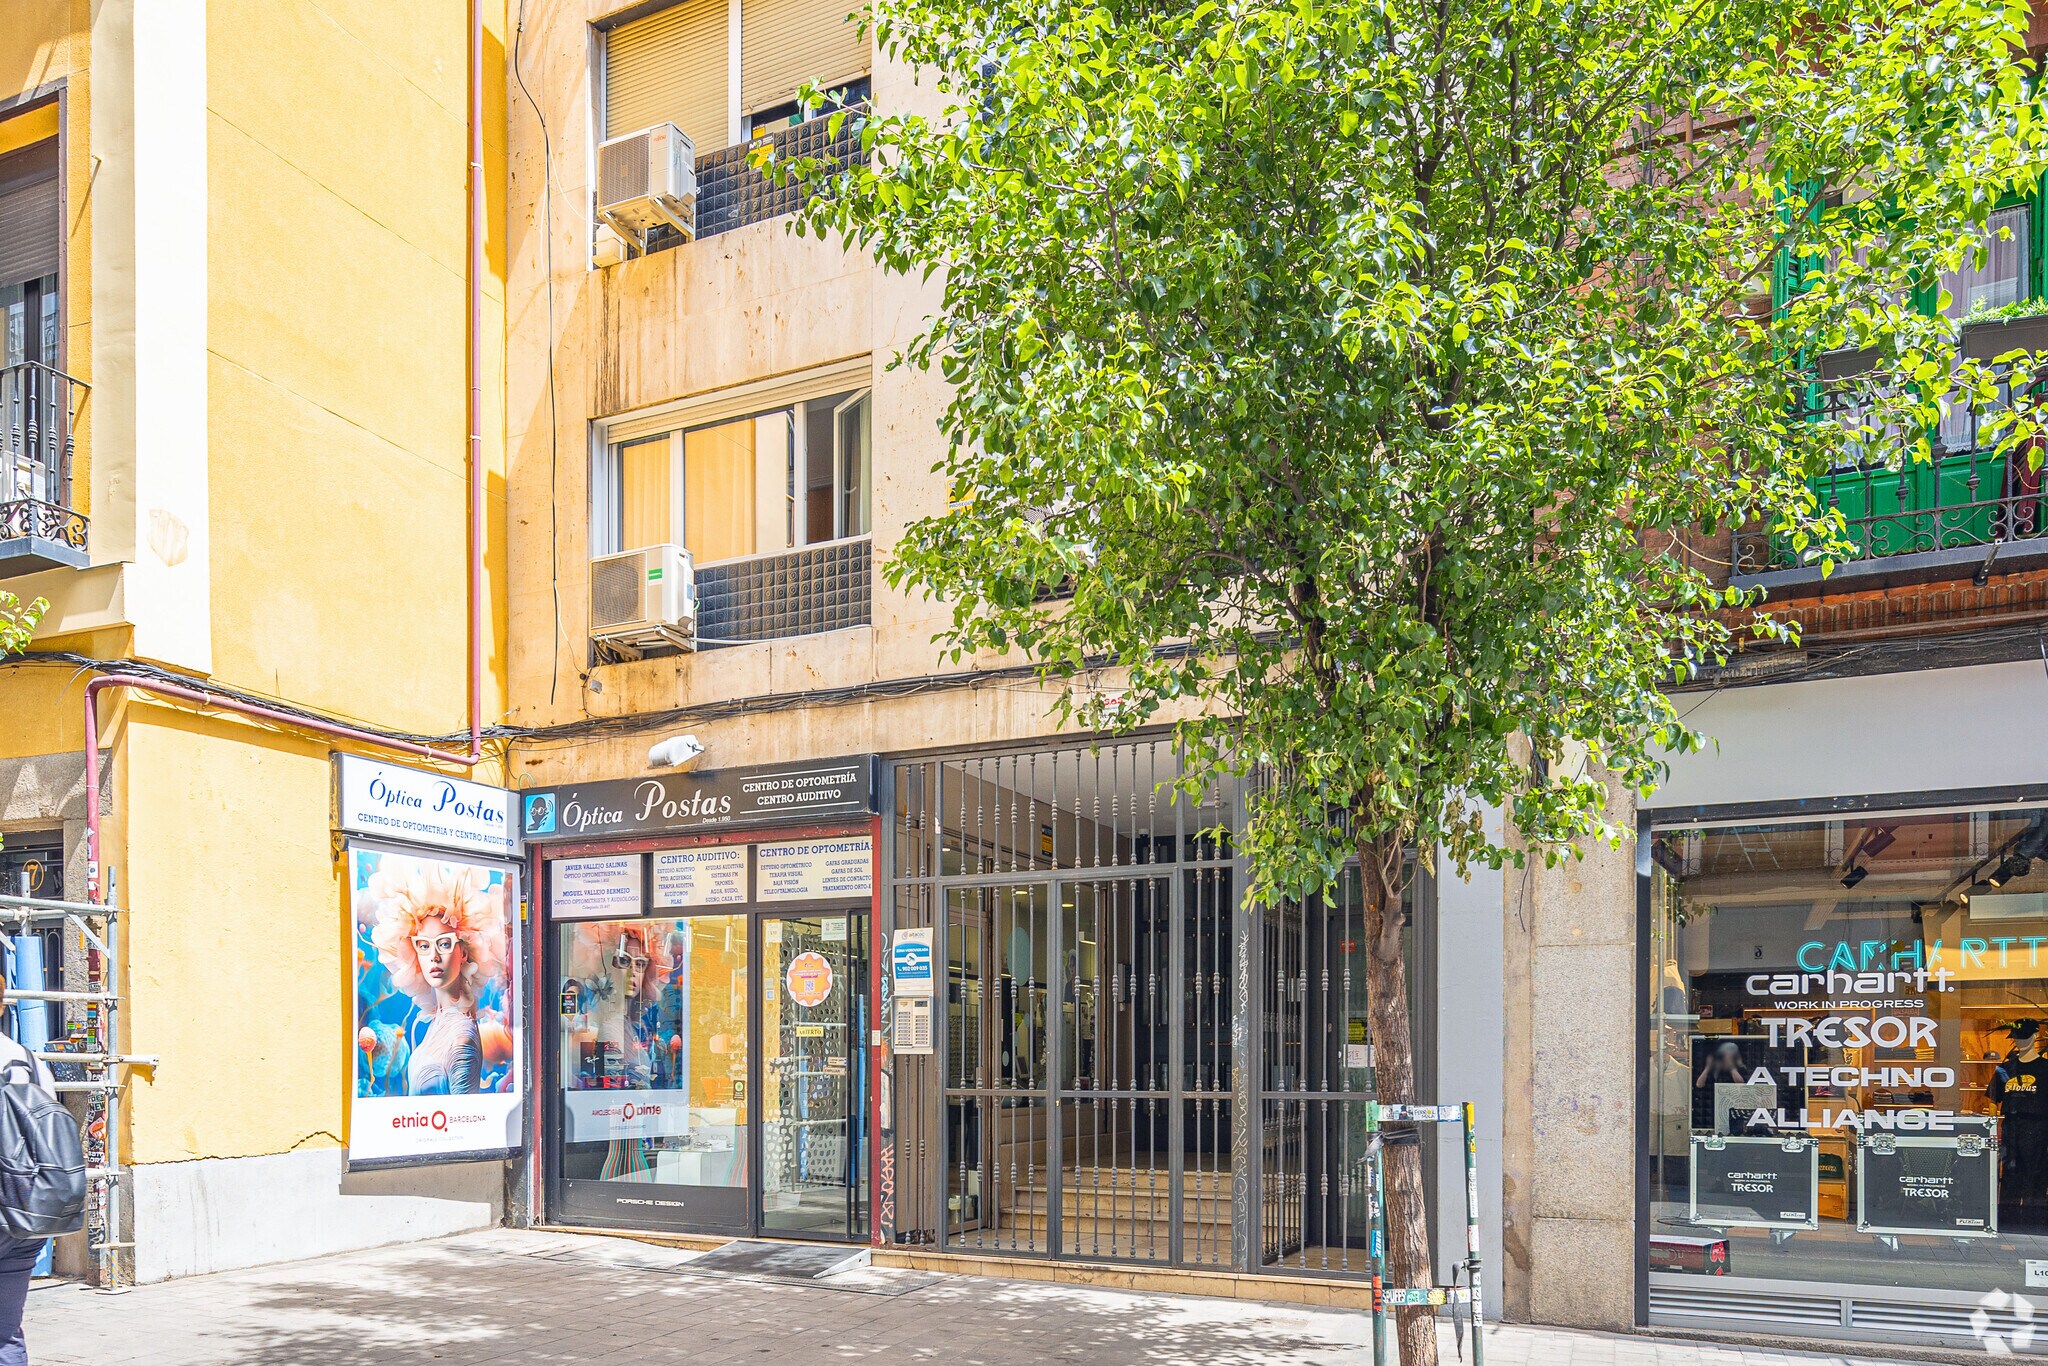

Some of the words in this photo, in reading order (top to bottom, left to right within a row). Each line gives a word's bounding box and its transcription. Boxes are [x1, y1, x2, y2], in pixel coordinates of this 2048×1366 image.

[742, 780, 780, 793] CENTRO
[782, 778, 794, 789] DE
[796, 771, 857, 787] OPTOMETRÍA
[369, 771, 422, 807] Óptica
[433, 780, 505, 823] Postas
[757, 793, 795, 806] CENTRO
[796, 789, 841, 802] AUDITIVO
[562, 792, 624, 832] Óptica
[634, 780, 732, 822] Postas
[702, 816, 717, 824] Desde
[358, 813, 389, 826] CENTRO
[391, 818, 401, 828] DE
[448, 828, 454, 837] Y
[456, 830, 482, 842] CENTRO
[483, 832, 514, 847] AUDITIVO
[660, 854, 694, 864] CENTRO
[696, 851, 740, 862] AUDITIVO:
[760, 847, 796, 858] CENTRO
[797, 846, 809, 855] DE
[565, 864, 582, 872] JAVIER
[841, 858, 869, 866] GRADUADAS
[27, 864, 39, 886] 7
[1774, 1000, 1818, 1010] WORK
[1822, 1000, 1836, 1008] IN
[1840, 1000, 1924, 1009] PROGRESS
[1760, 1016, 1939, 1048] TRESOR
[1746, 1066, 1777, 1086] A
[1780, 1067, 1955, 1088] TECHNO
[392, 1112, 428, 1129] etnia
[449, 1115, 486, 1124] BARCELONA
[1746, 1108, 1954, 1130] ALLIANCE
[1731, 1183, 1774, 1192] TRESOR
[1902, 1188, 1949, 1198] TRESOR
